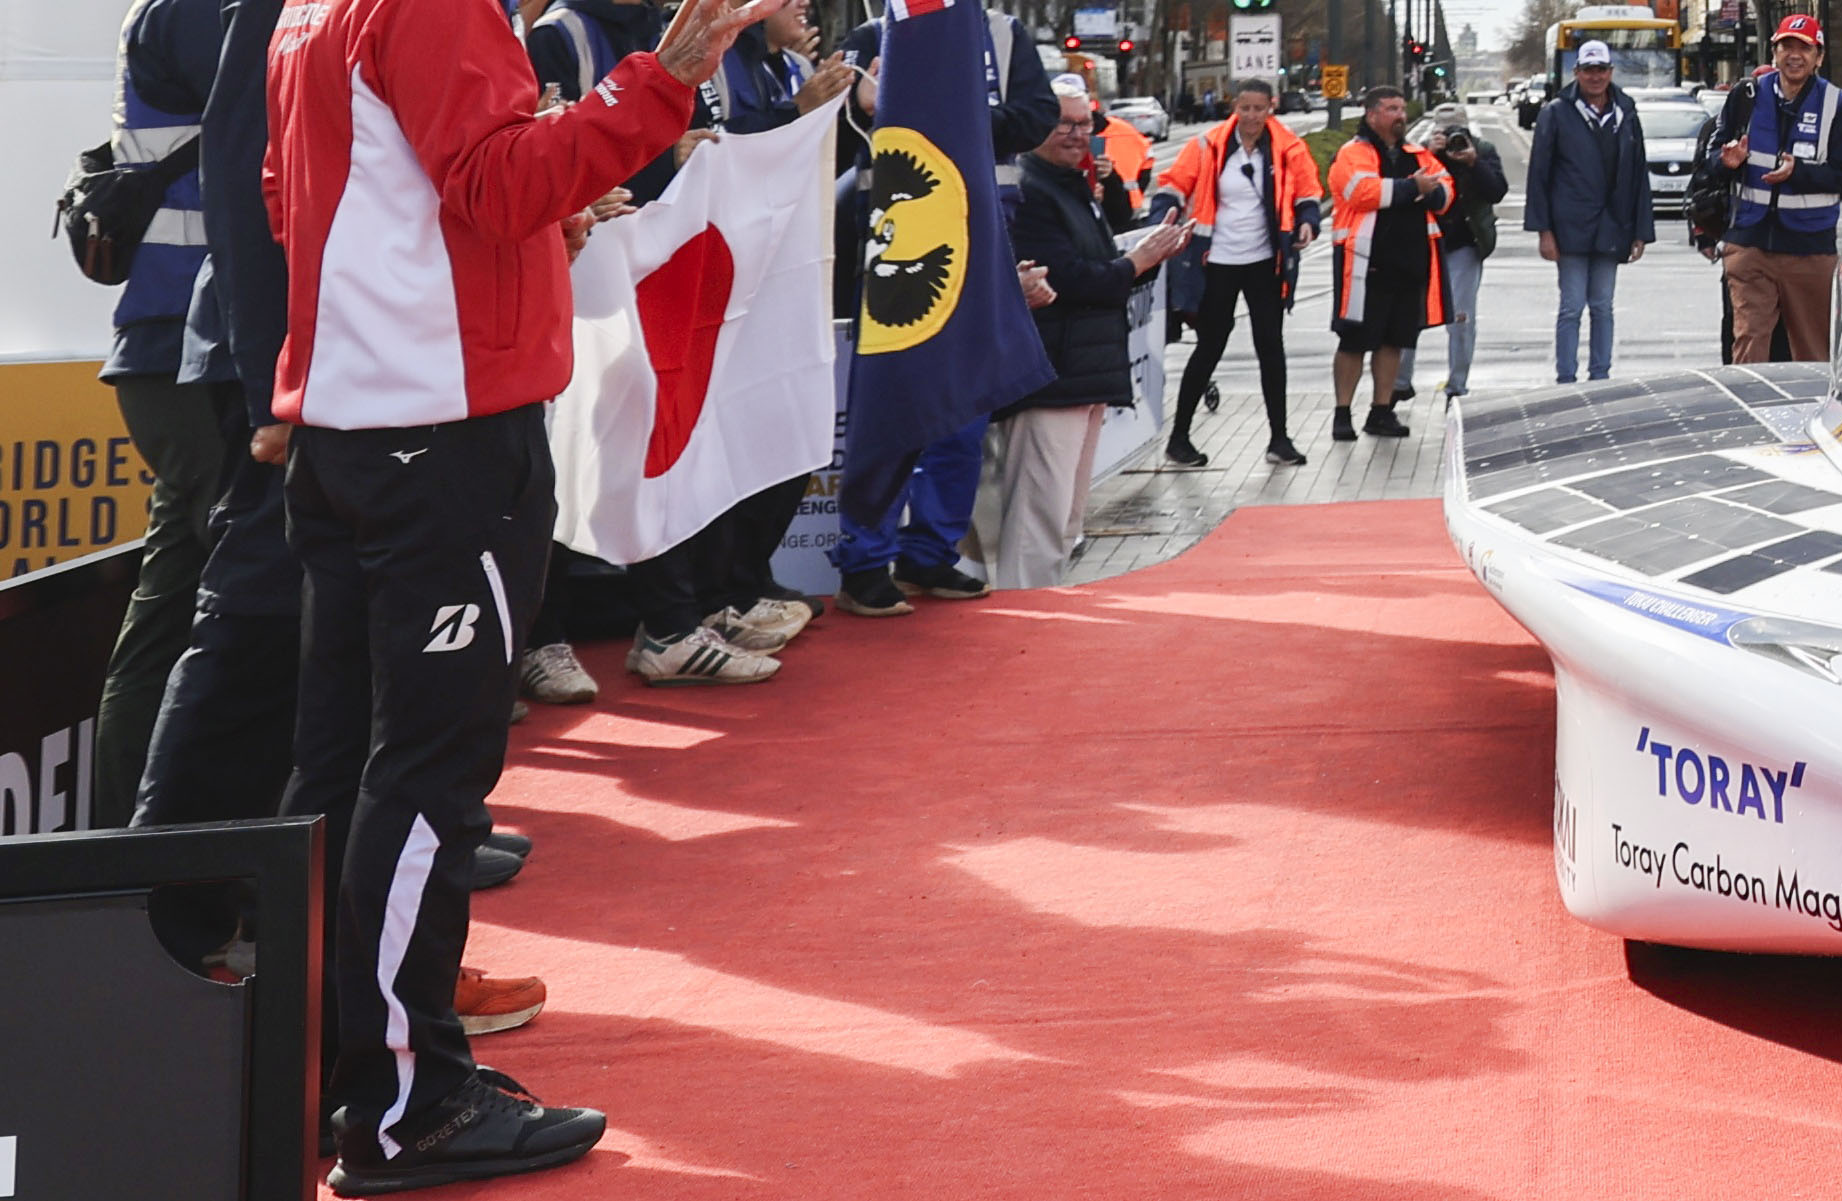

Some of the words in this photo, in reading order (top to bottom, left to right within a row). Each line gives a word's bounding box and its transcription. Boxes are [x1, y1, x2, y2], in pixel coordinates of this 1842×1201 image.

[1236, 55, 1274, 70] LANE
[1612, 823, 1666, 888] Toray
[1672, 842, 1767, 906] Carbon
